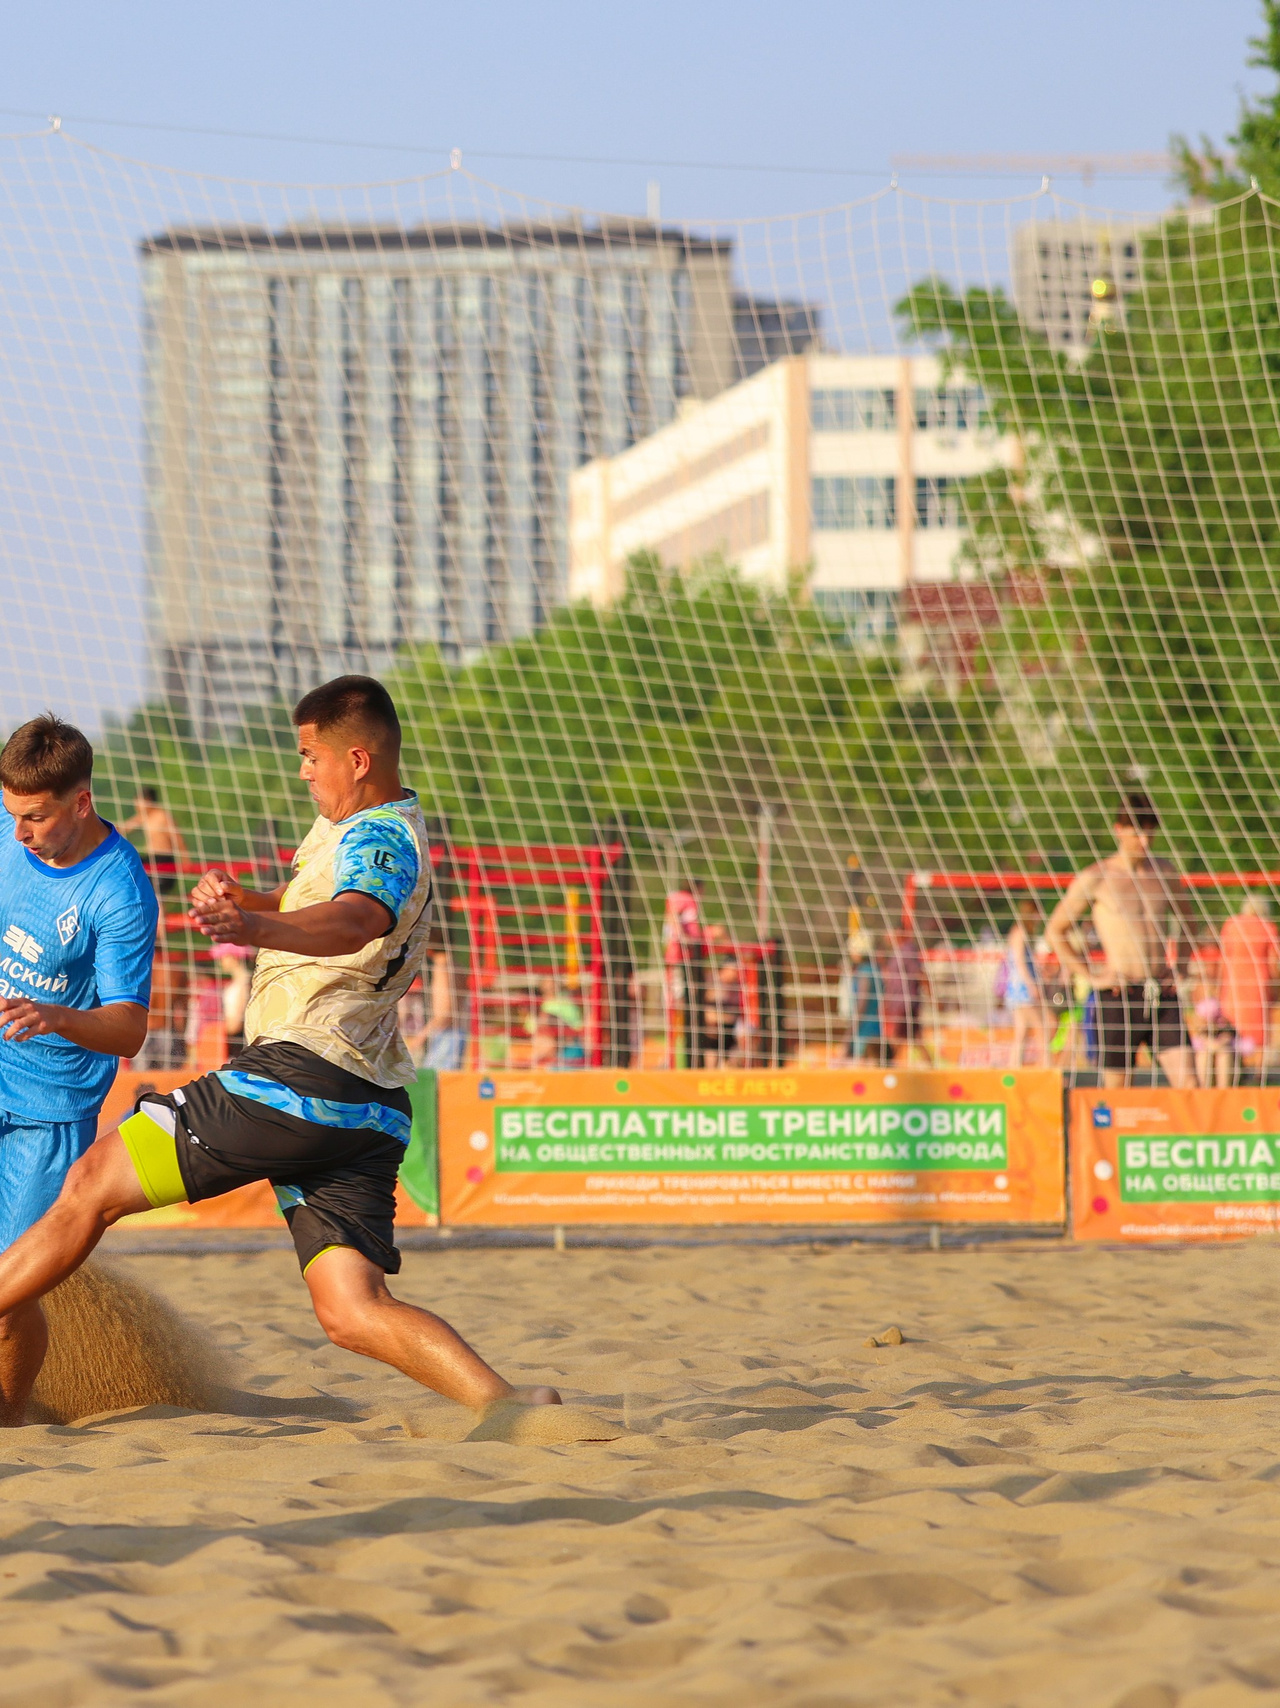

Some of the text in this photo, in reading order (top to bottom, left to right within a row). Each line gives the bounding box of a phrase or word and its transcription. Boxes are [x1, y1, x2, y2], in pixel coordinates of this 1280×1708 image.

[742, 1080, 798, 1097] ЛЕТО
[501, 1109, 1002, 1138] БЕСПЛАТНЫЕ ТРЕНИРОВКИ
[501, 1142, 1006, 1164] НА ОБЩЕСТВЕННЫХ ПРОСТРАНСТВАХ ГОРОДА
[1125, 1140, 1280, 1168] БЕСПЛА
[1125, 1175, 1157, 1192] НА
